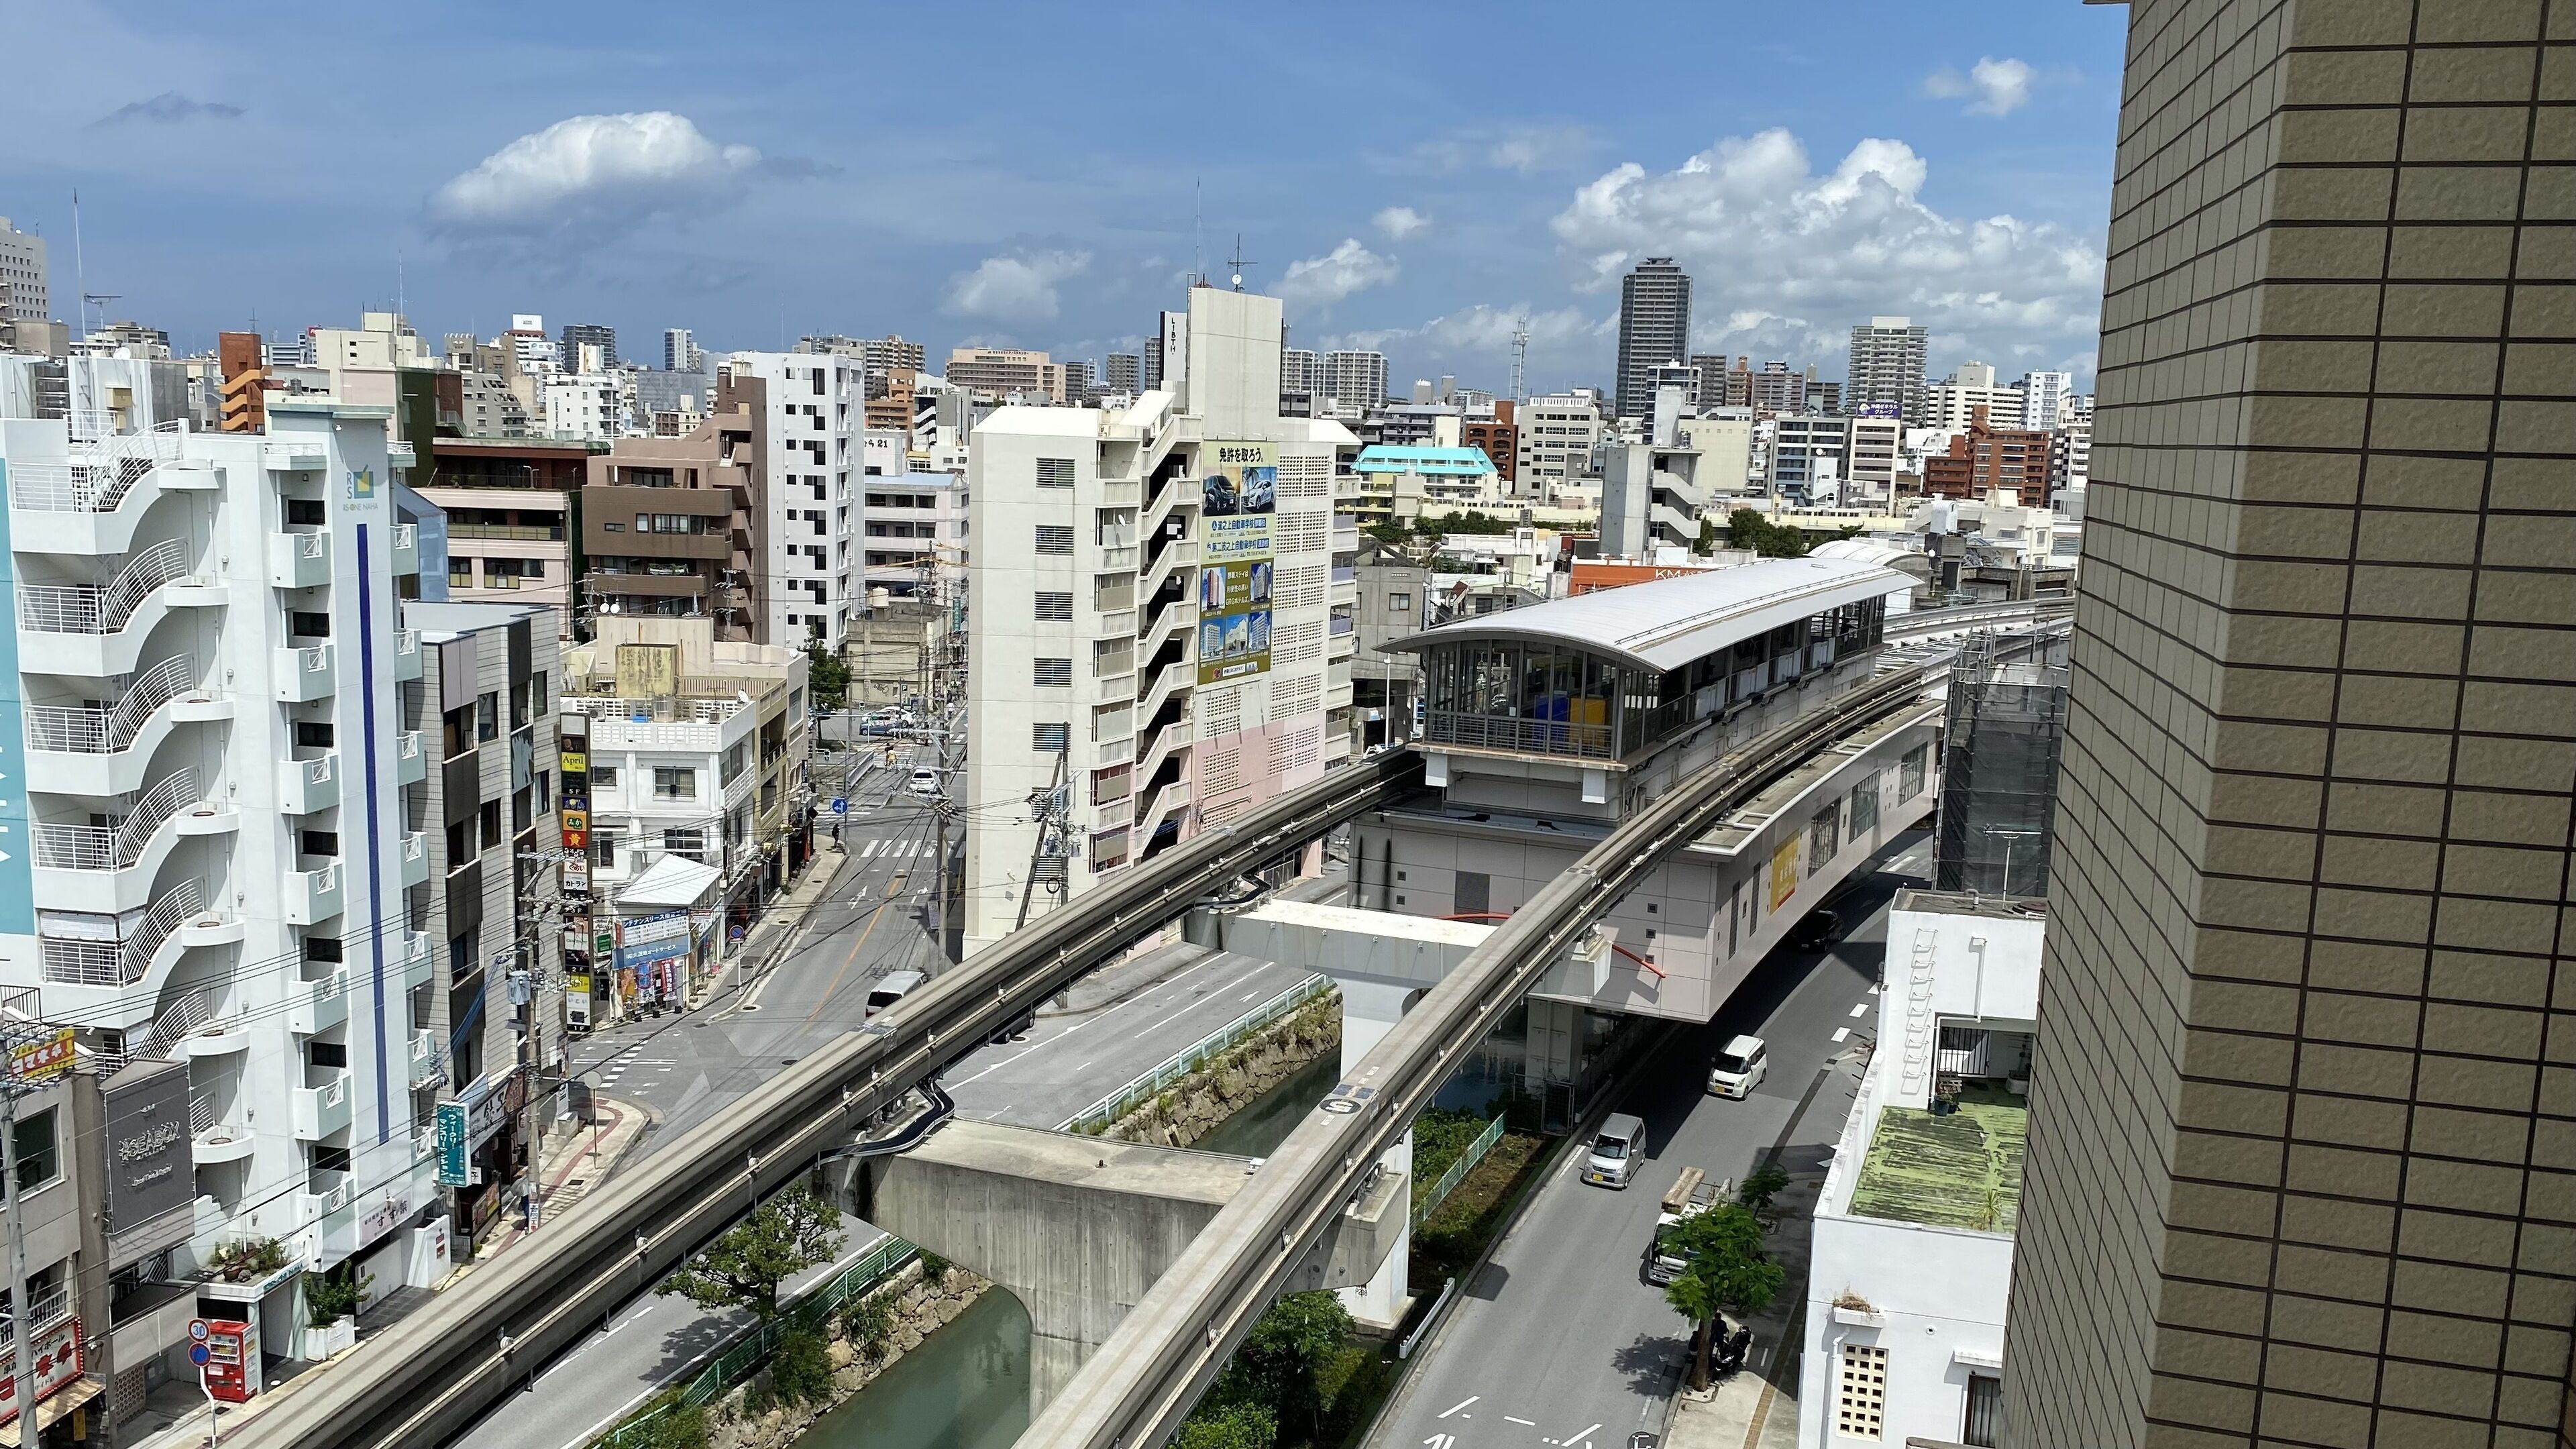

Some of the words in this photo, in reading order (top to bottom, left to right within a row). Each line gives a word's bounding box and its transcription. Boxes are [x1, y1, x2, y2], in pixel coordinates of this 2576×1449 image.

[877, 439, 888, 448] 21
[1220, 447, 1263, 463] 免許を取ろう。
[563, 755, 584, 765] April
[448, 1114, 457, 1149] ウィークリー
[193, 1325, 205, 1337] 30
[31, 1334, 66, 1358] ハイボール
